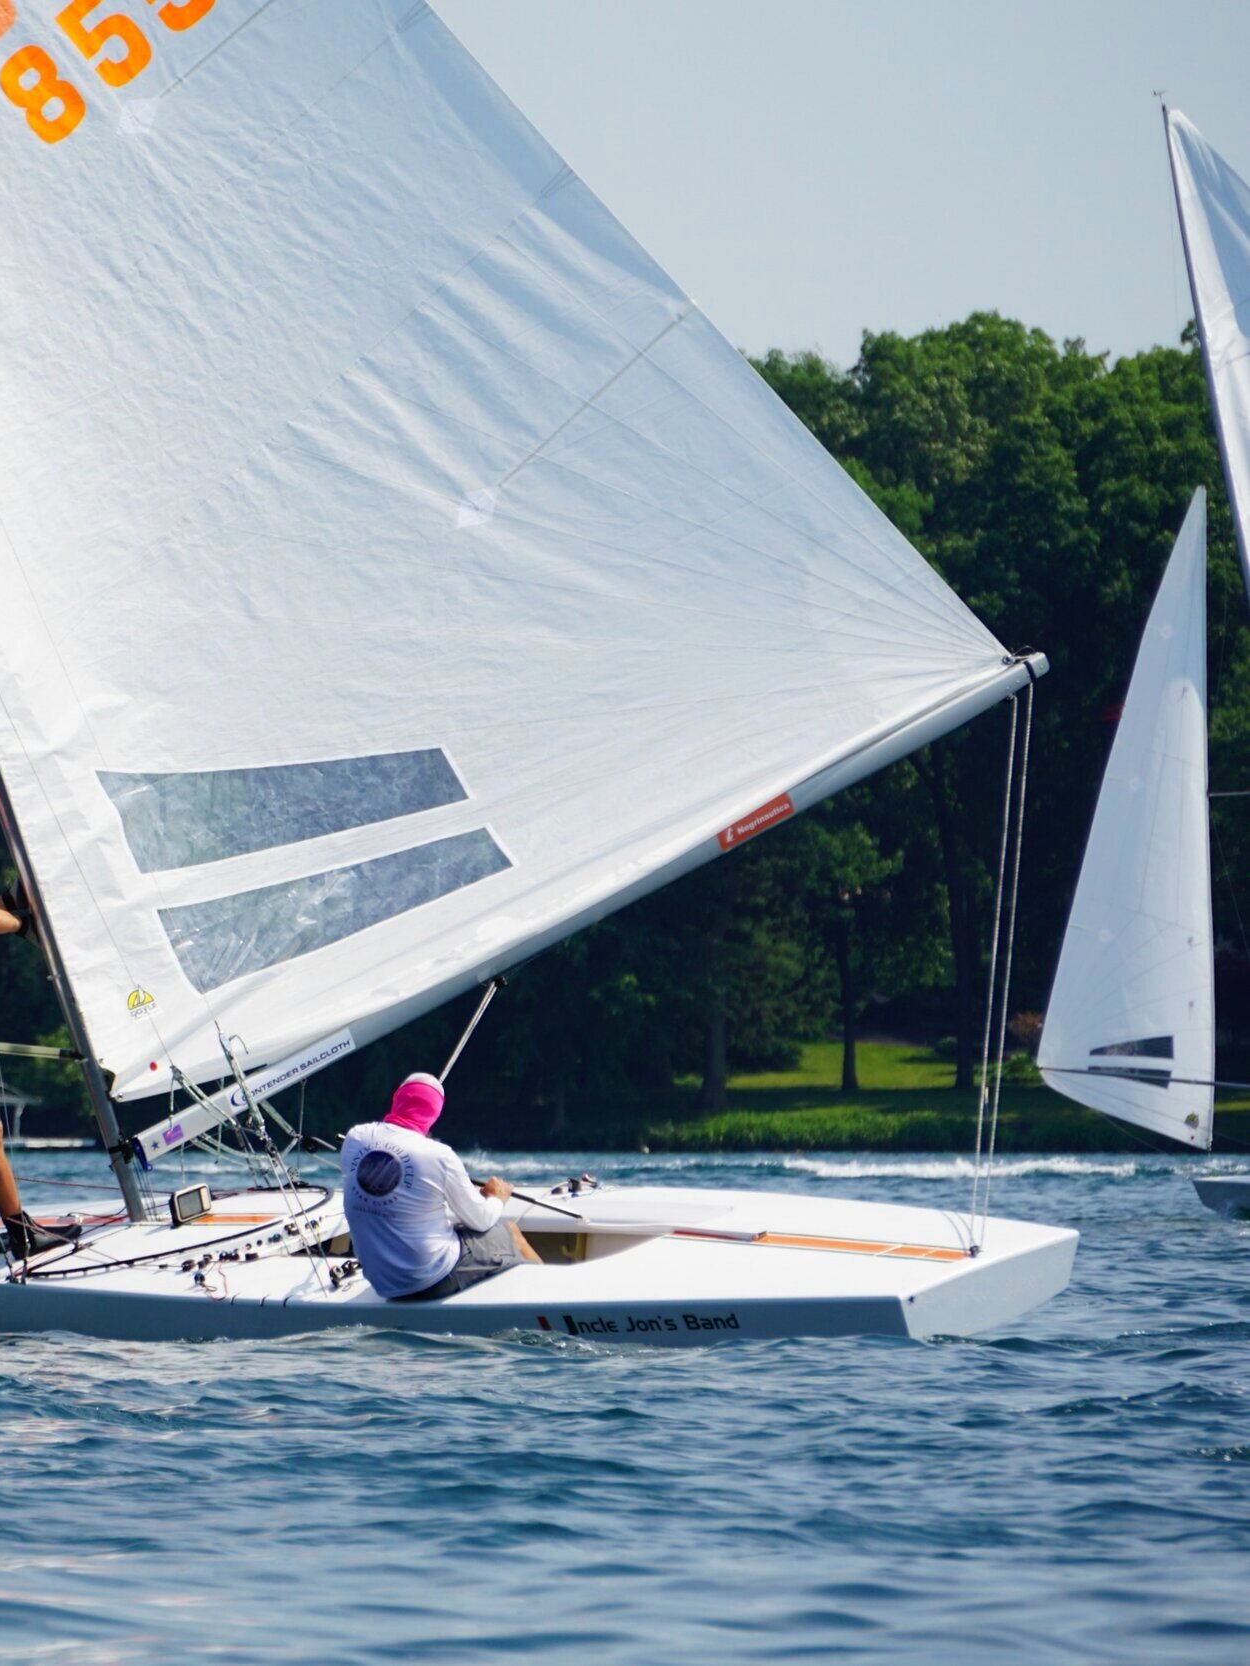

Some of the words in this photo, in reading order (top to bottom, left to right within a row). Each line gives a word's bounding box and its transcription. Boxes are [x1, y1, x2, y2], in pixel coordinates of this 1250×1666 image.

[299, 1039, 351, 1071] SAILCLOTH
[384, 1142, 411, 1164] GOLD
[403, 1165, 415, 1189] CUP
[626, 1315, 678, 1333] Jon's
[682, 1313, 740, 1331] Band
